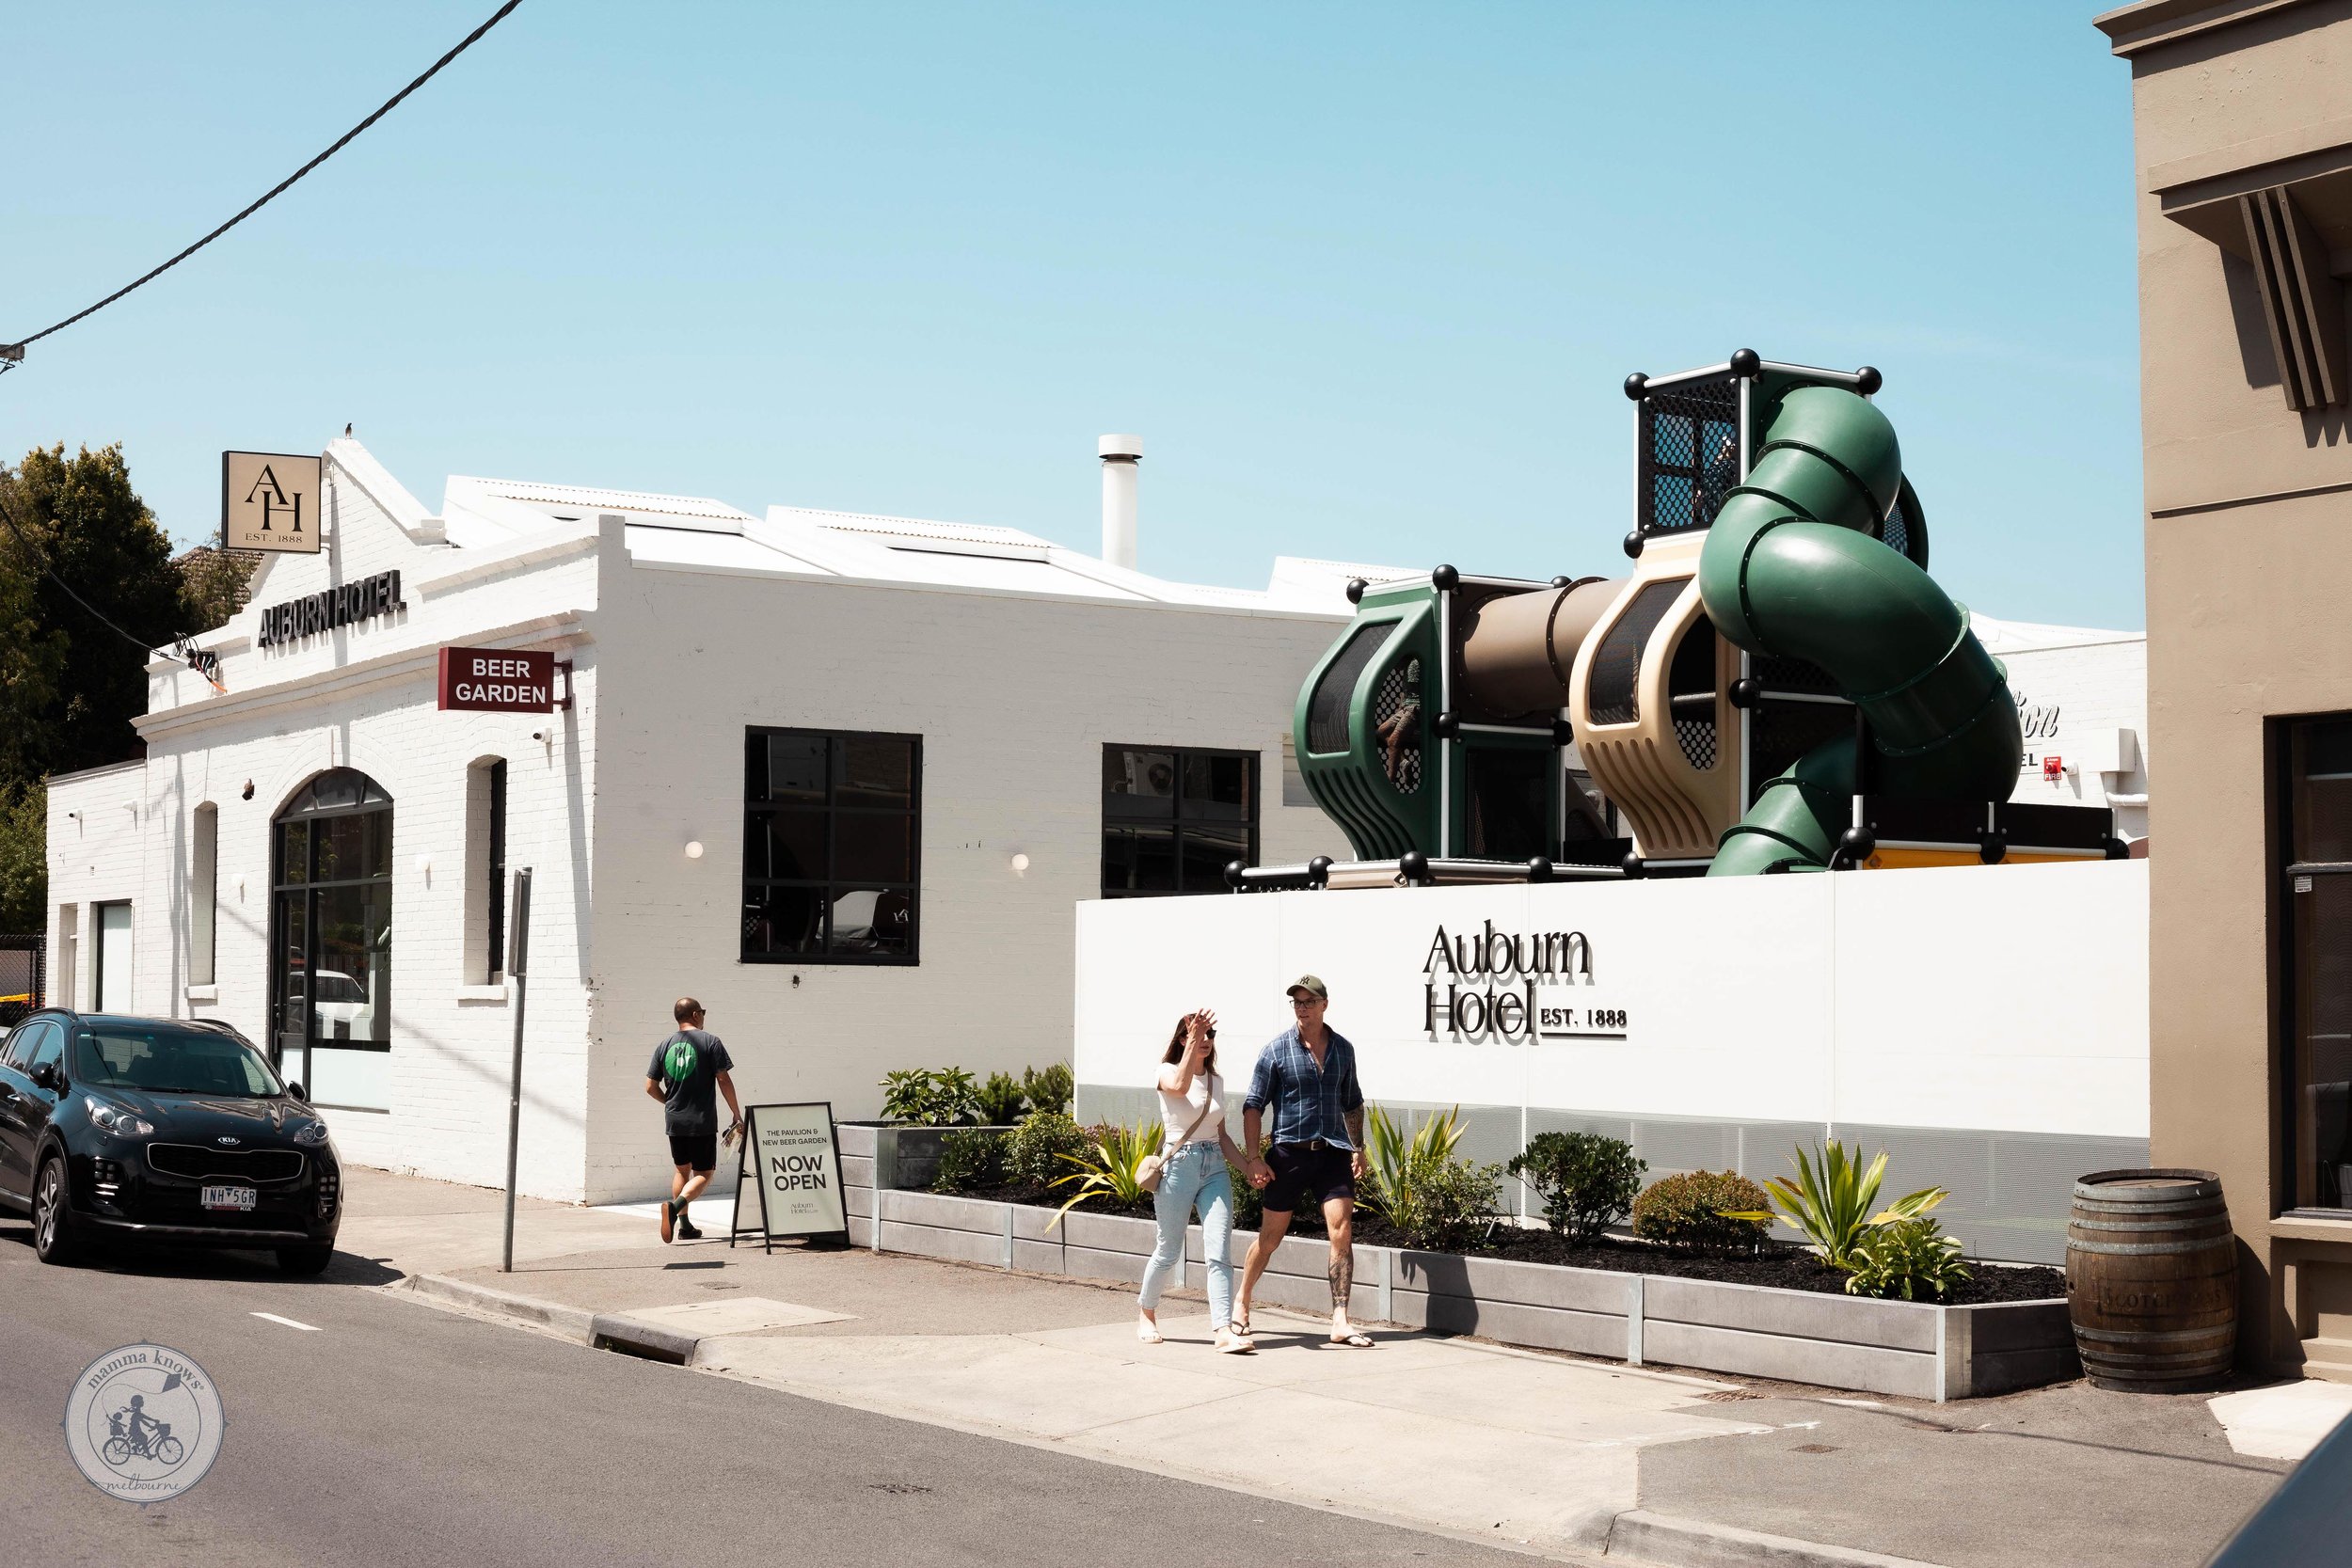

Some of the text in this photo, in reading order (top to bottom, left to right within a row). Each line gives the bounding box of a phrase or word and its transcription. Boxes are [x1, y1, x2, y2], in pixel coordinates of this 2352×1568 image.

[245, 532, 303, 544] EST. 1888
[258, 569, 406, 647] AUBURN HOTEL
[472, 658, 531, 678] BEER
[455, 683, 546, 704] GARDEN
[1422, 919, 1590, 974] Auburn
[1423, 979, 1628, 1035] Hotel EST. 1888
[771, 1154, 823, 1174] NOW
[774, 1173, 827, 1192] OPEN
[233, 1190, 255, 1204] 5GR
